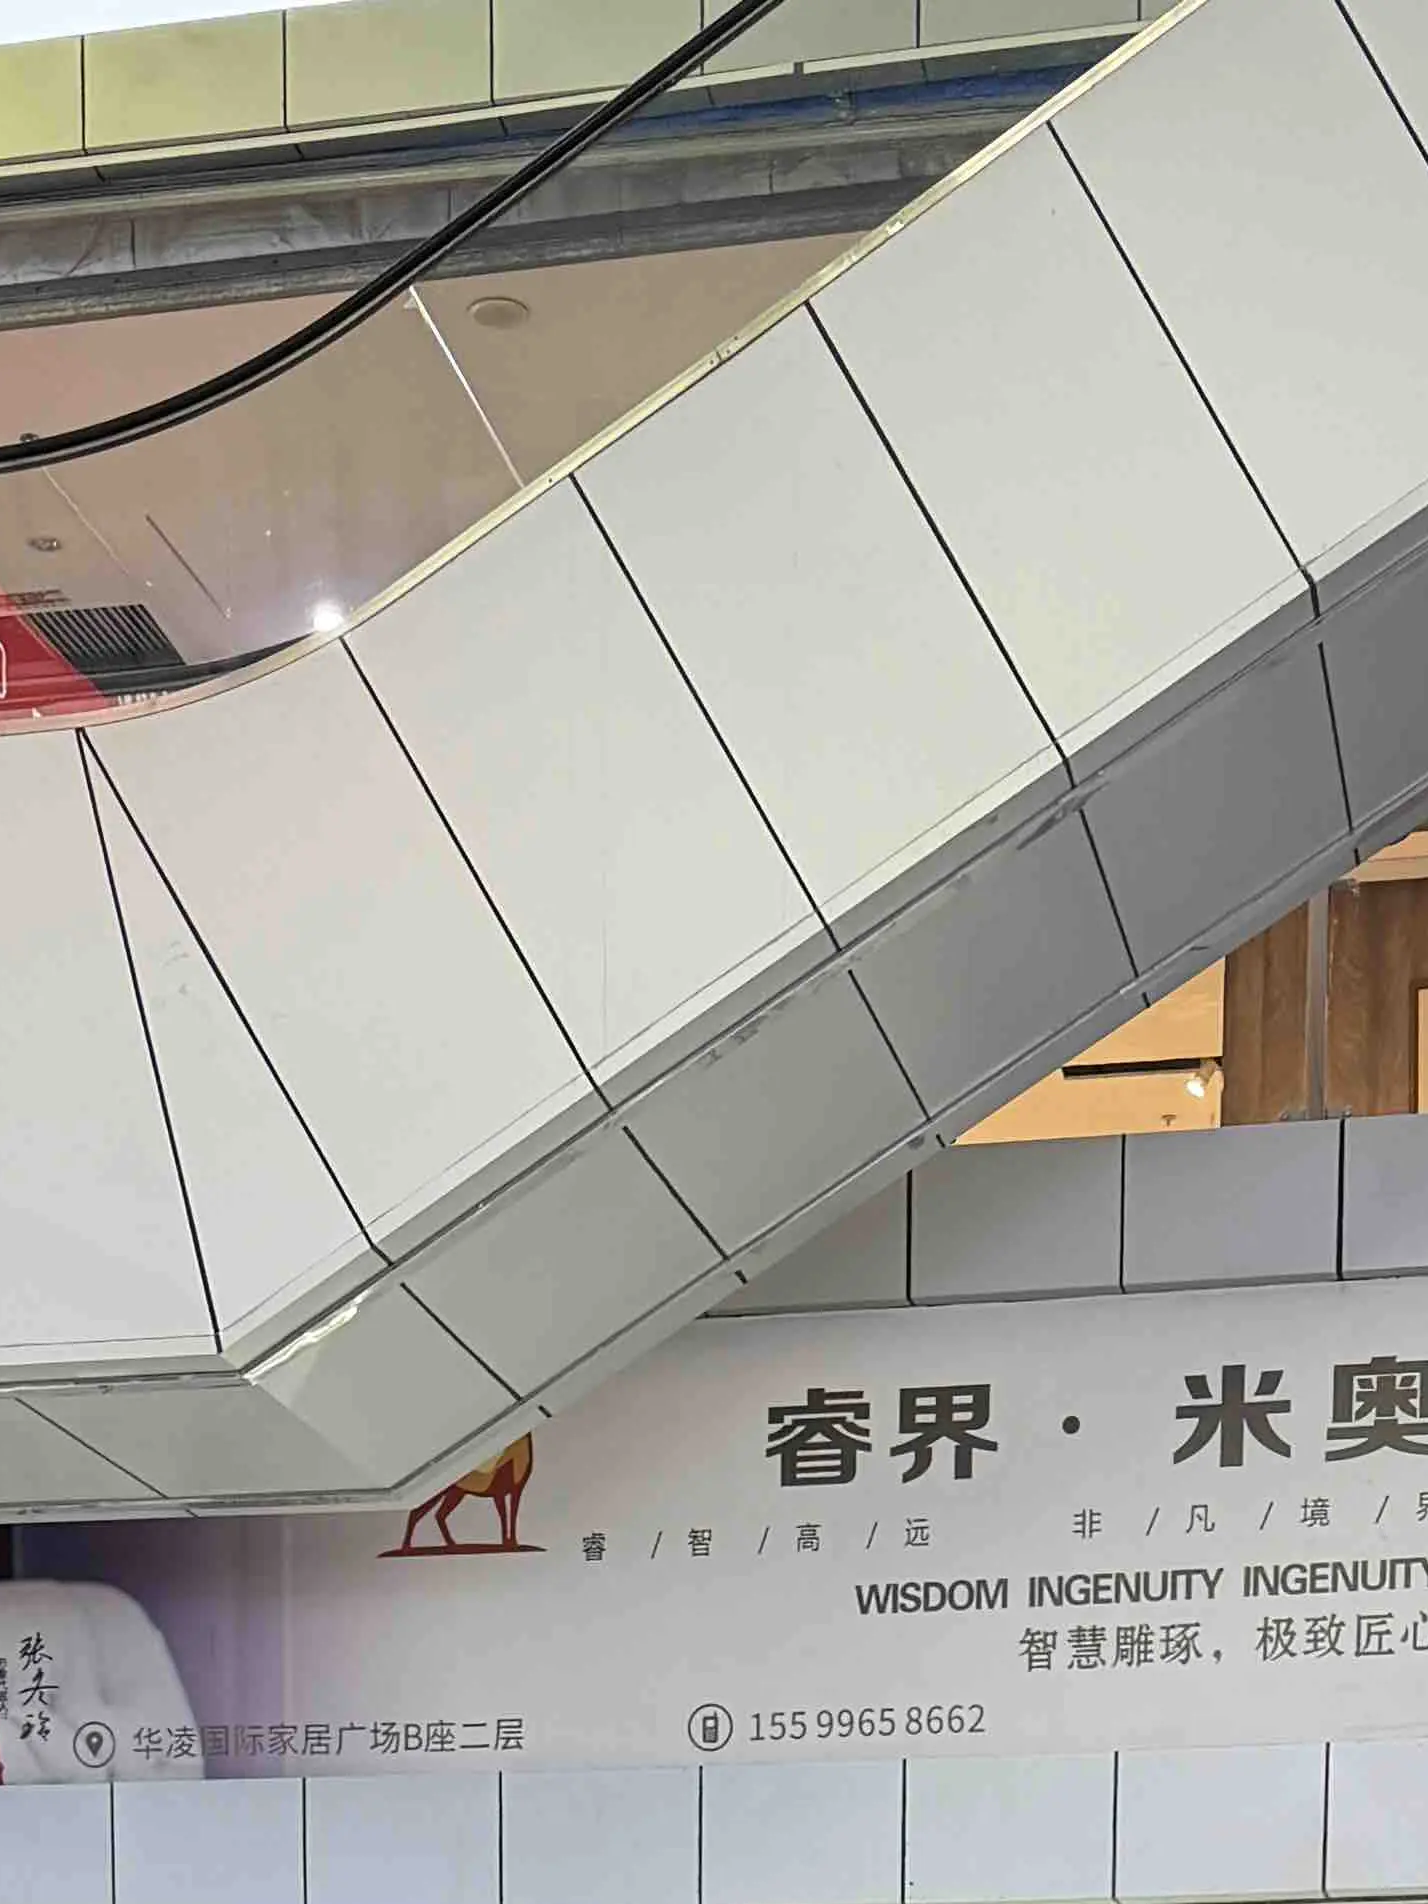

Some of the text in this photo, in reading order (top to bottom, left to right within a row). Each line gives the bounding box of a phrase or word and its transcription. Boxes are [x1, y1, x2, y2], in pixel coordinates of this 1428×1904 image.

[855, 1577, 1009, 1615] WISDOM
[1027, 1567, 1224, 1608] INGENUITY
[132, 1717, 524, 1760] 华凌国际家居广场B座二层
